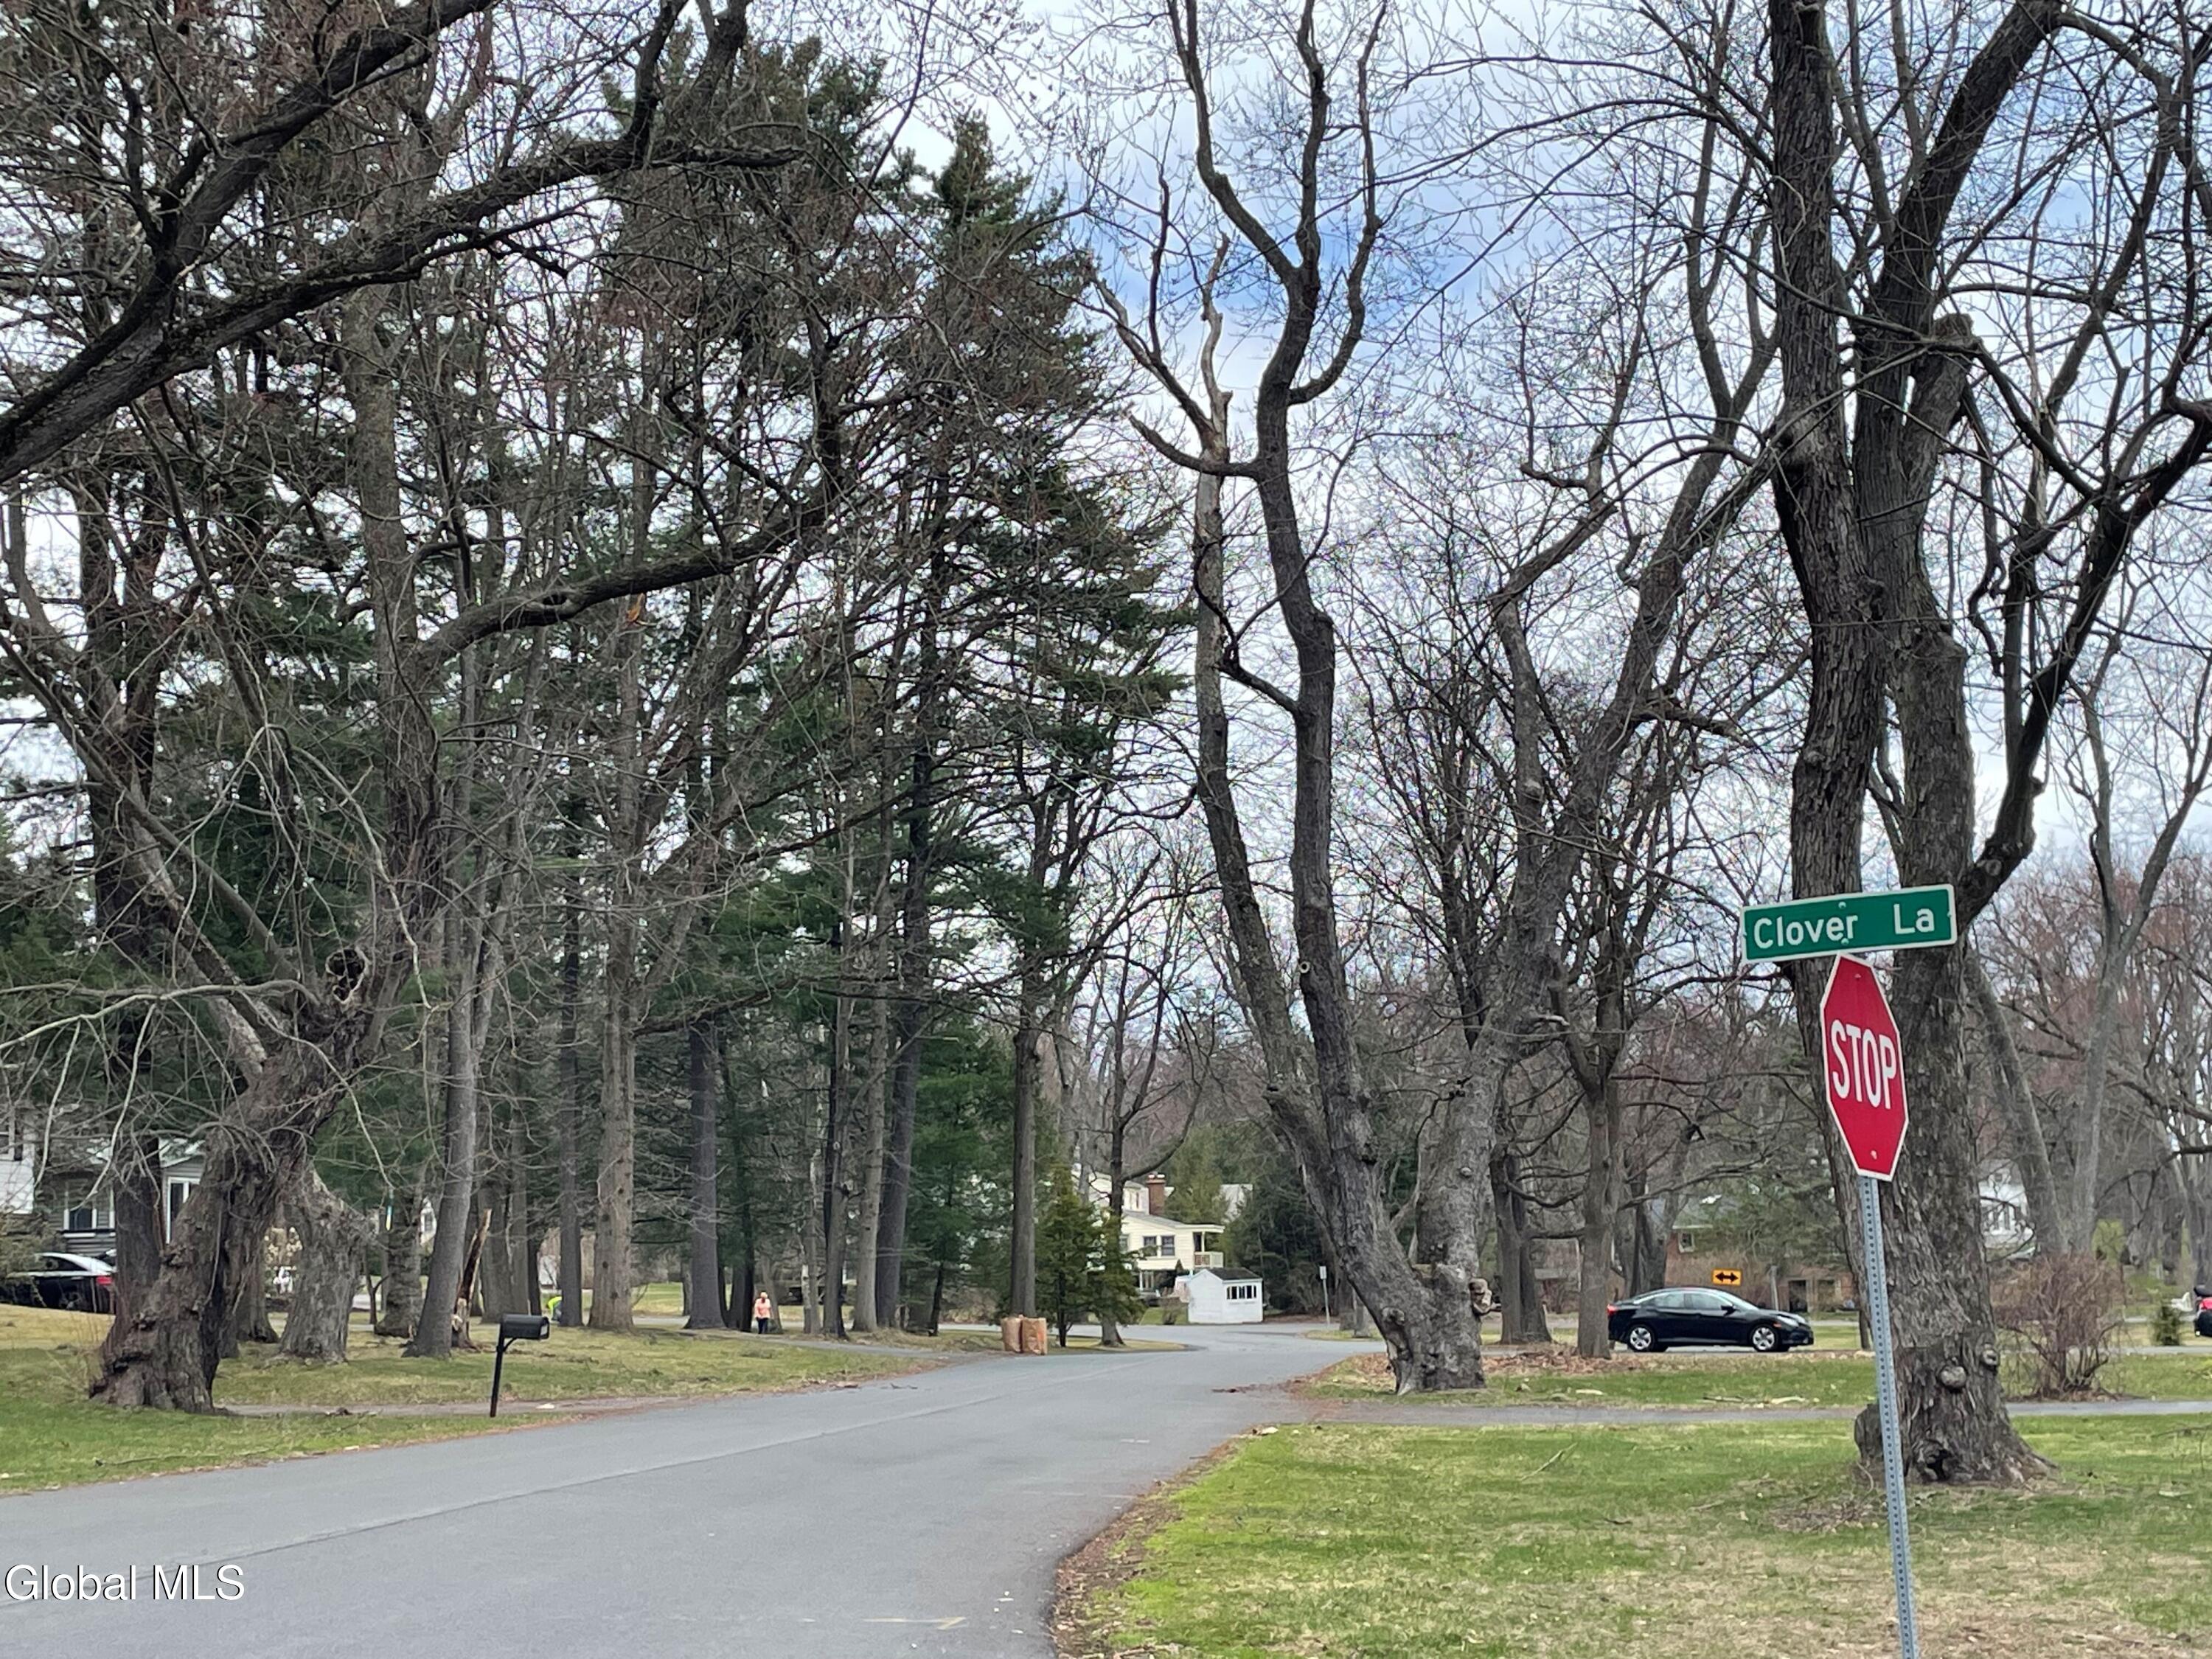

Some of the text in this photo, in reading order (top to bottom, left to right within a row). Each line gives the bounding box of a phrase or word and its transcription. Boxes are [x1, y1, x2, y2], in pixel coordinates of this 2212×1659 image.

[1753, 903, 1935, 950] Clover La
[1831, 1019, 1896, 1109] STOP
